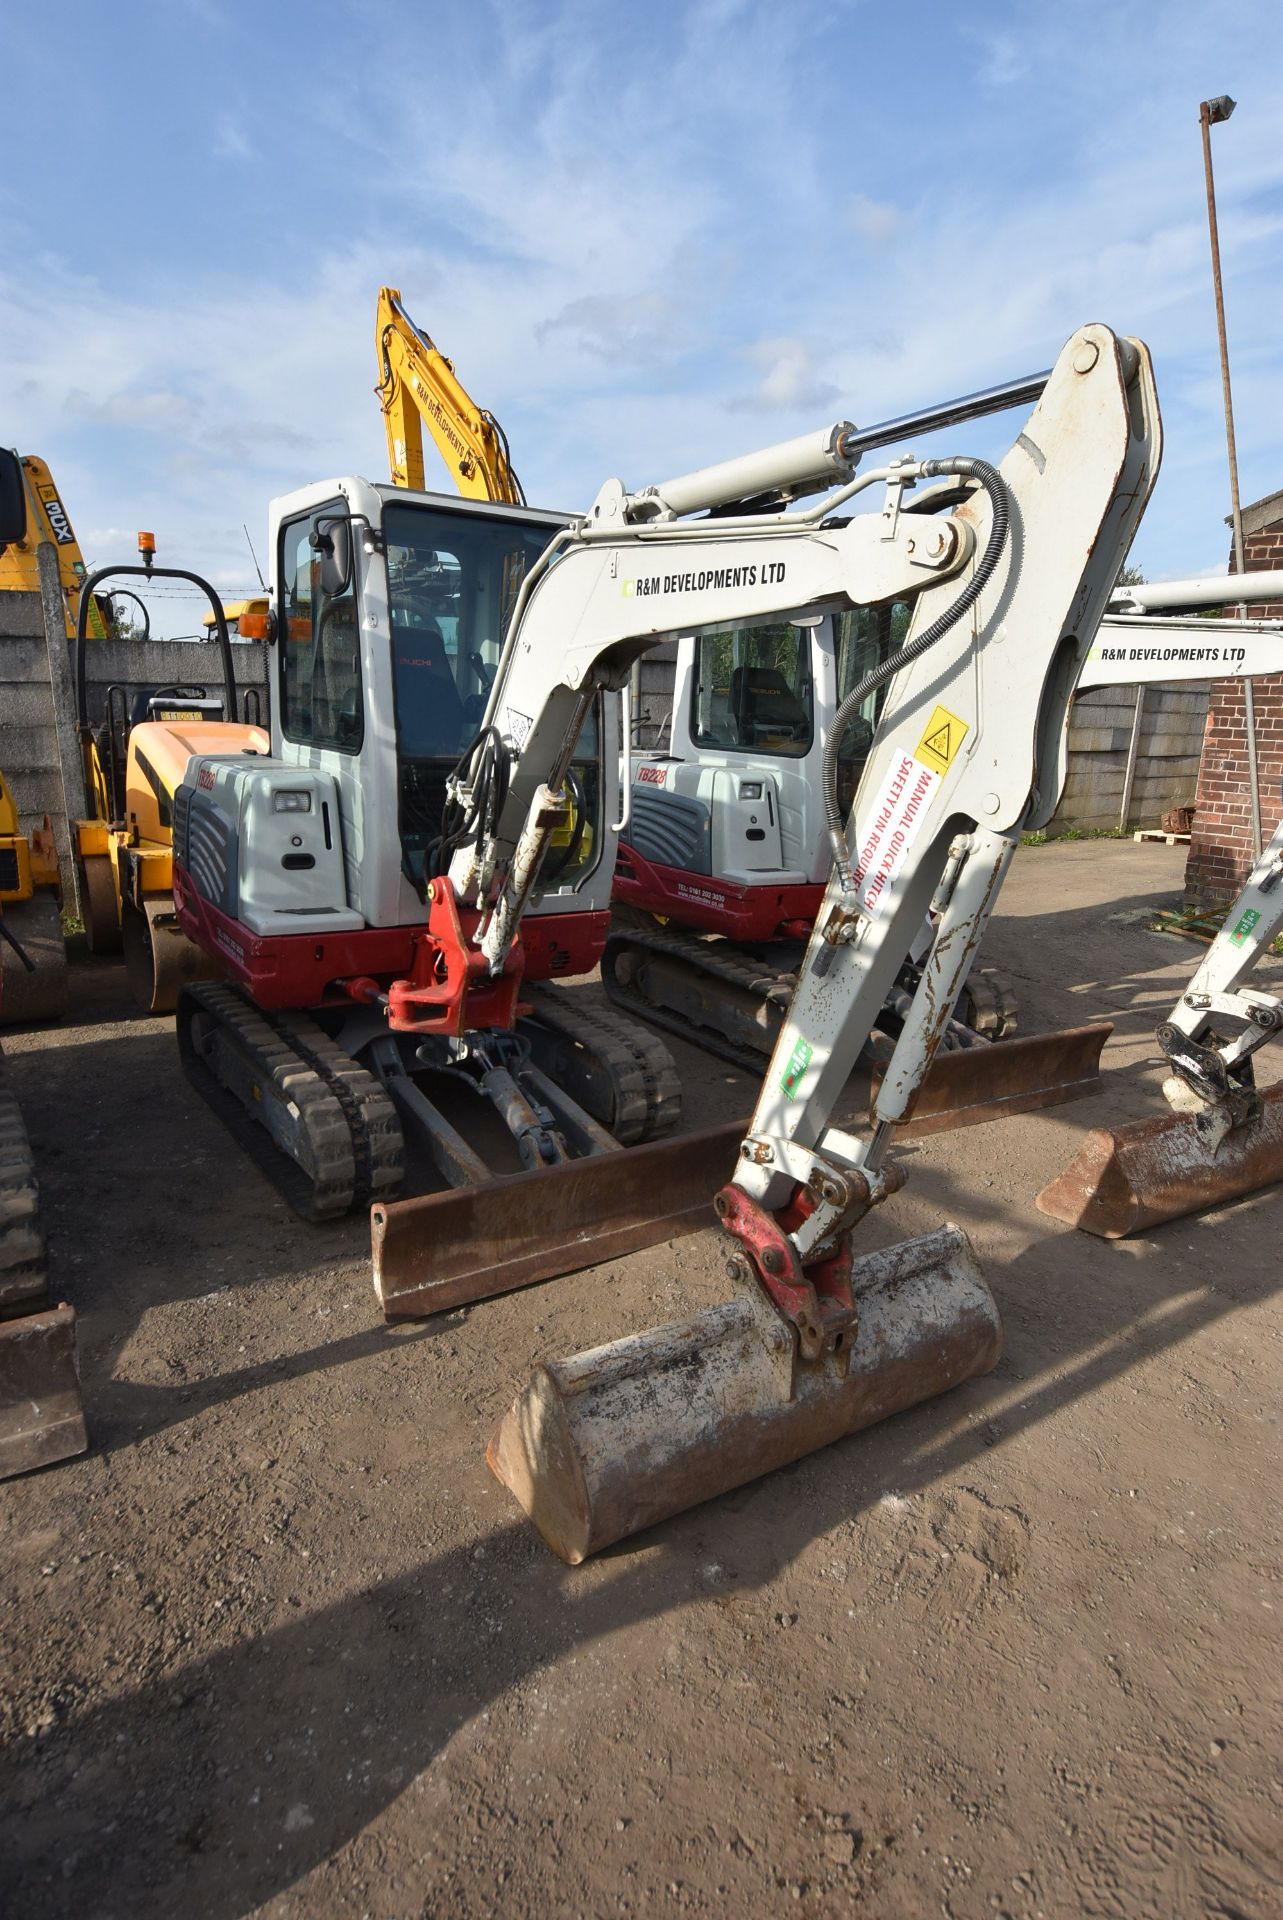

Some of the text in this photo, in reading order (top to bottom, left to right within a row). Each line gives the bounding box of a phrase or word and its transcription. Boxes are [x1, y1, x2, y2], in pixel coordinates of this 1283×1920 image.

[428, 400, 465, 458] DEVELOPMENTS
[45, 501, 73, 541] 3CX
[636, 562, 786, 597] R&M DEVELOPMENTS LTD
[1101, 648, 1246, 661] R&M DEVELOPMENTS LTD
[638, 767, 668, 784] TB228
[885, 756, 913, 811] SAFETY
[875, 806, 892, 833] PIN
[863, 770, 932, 910] MANUAL QUICK HITCH
